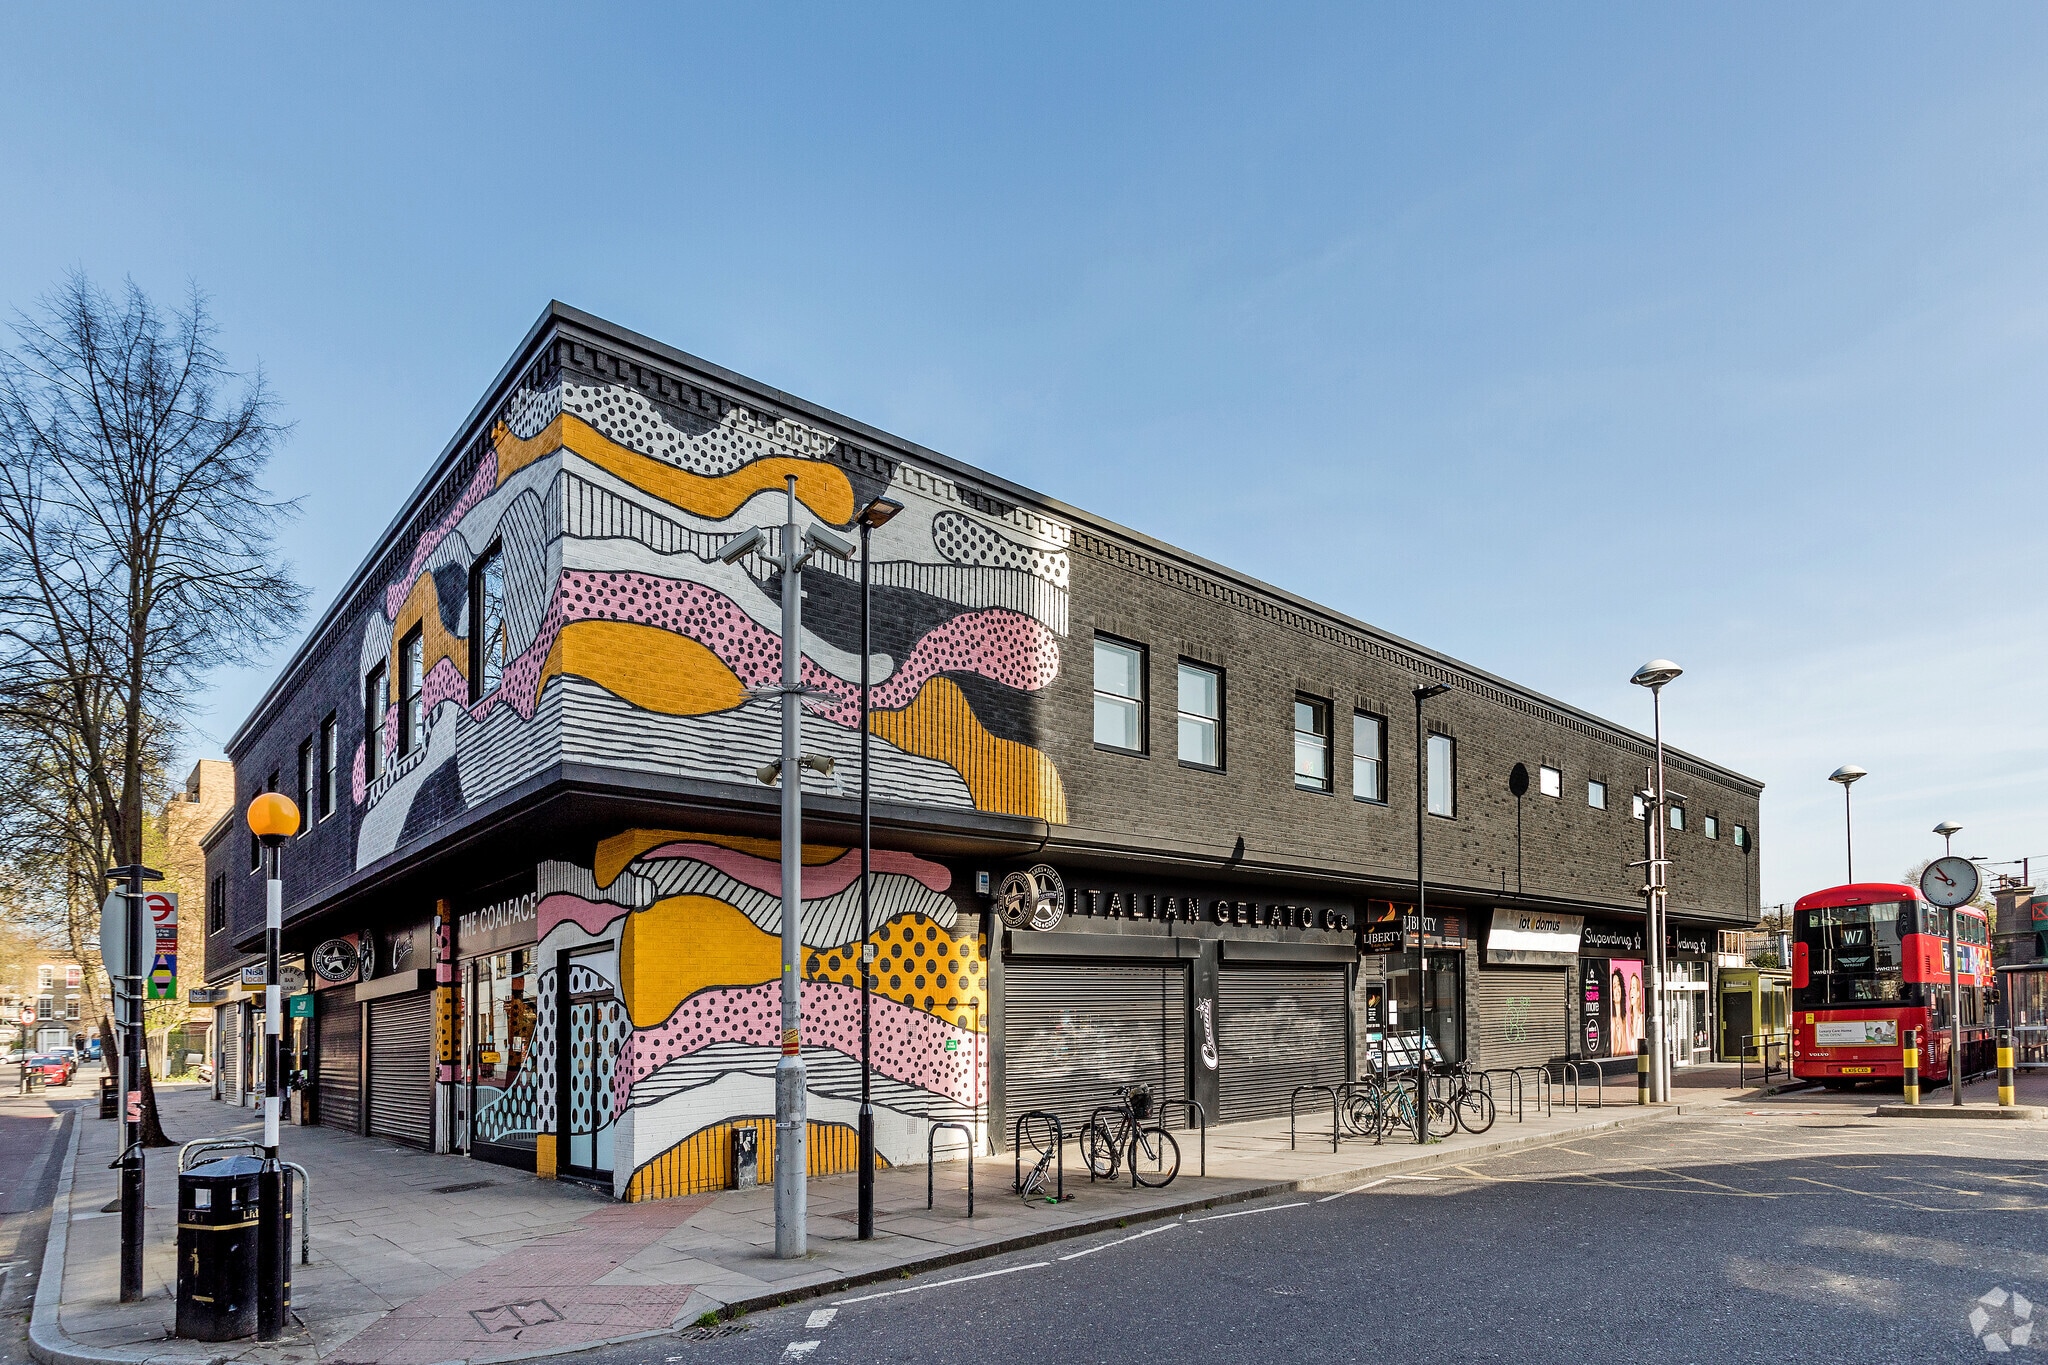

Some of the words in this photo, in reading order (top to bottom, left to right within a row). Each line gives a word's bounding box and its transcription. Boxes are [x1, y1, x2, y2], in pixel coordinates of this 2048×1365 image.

[460, 911, 477, 938] THE
[480, 892, 537, 933] COALFACE
[1073, 887, 1200, 921] ITALIAN
[1217, 900, 1313, 928] GELATO
[1363, 930, 1403, 945] LIBERTY
[1585, 927, 1632, 950] Superdrug
[1844, 930, 1864, 944] W7
[246, 975, 264, 983] local
